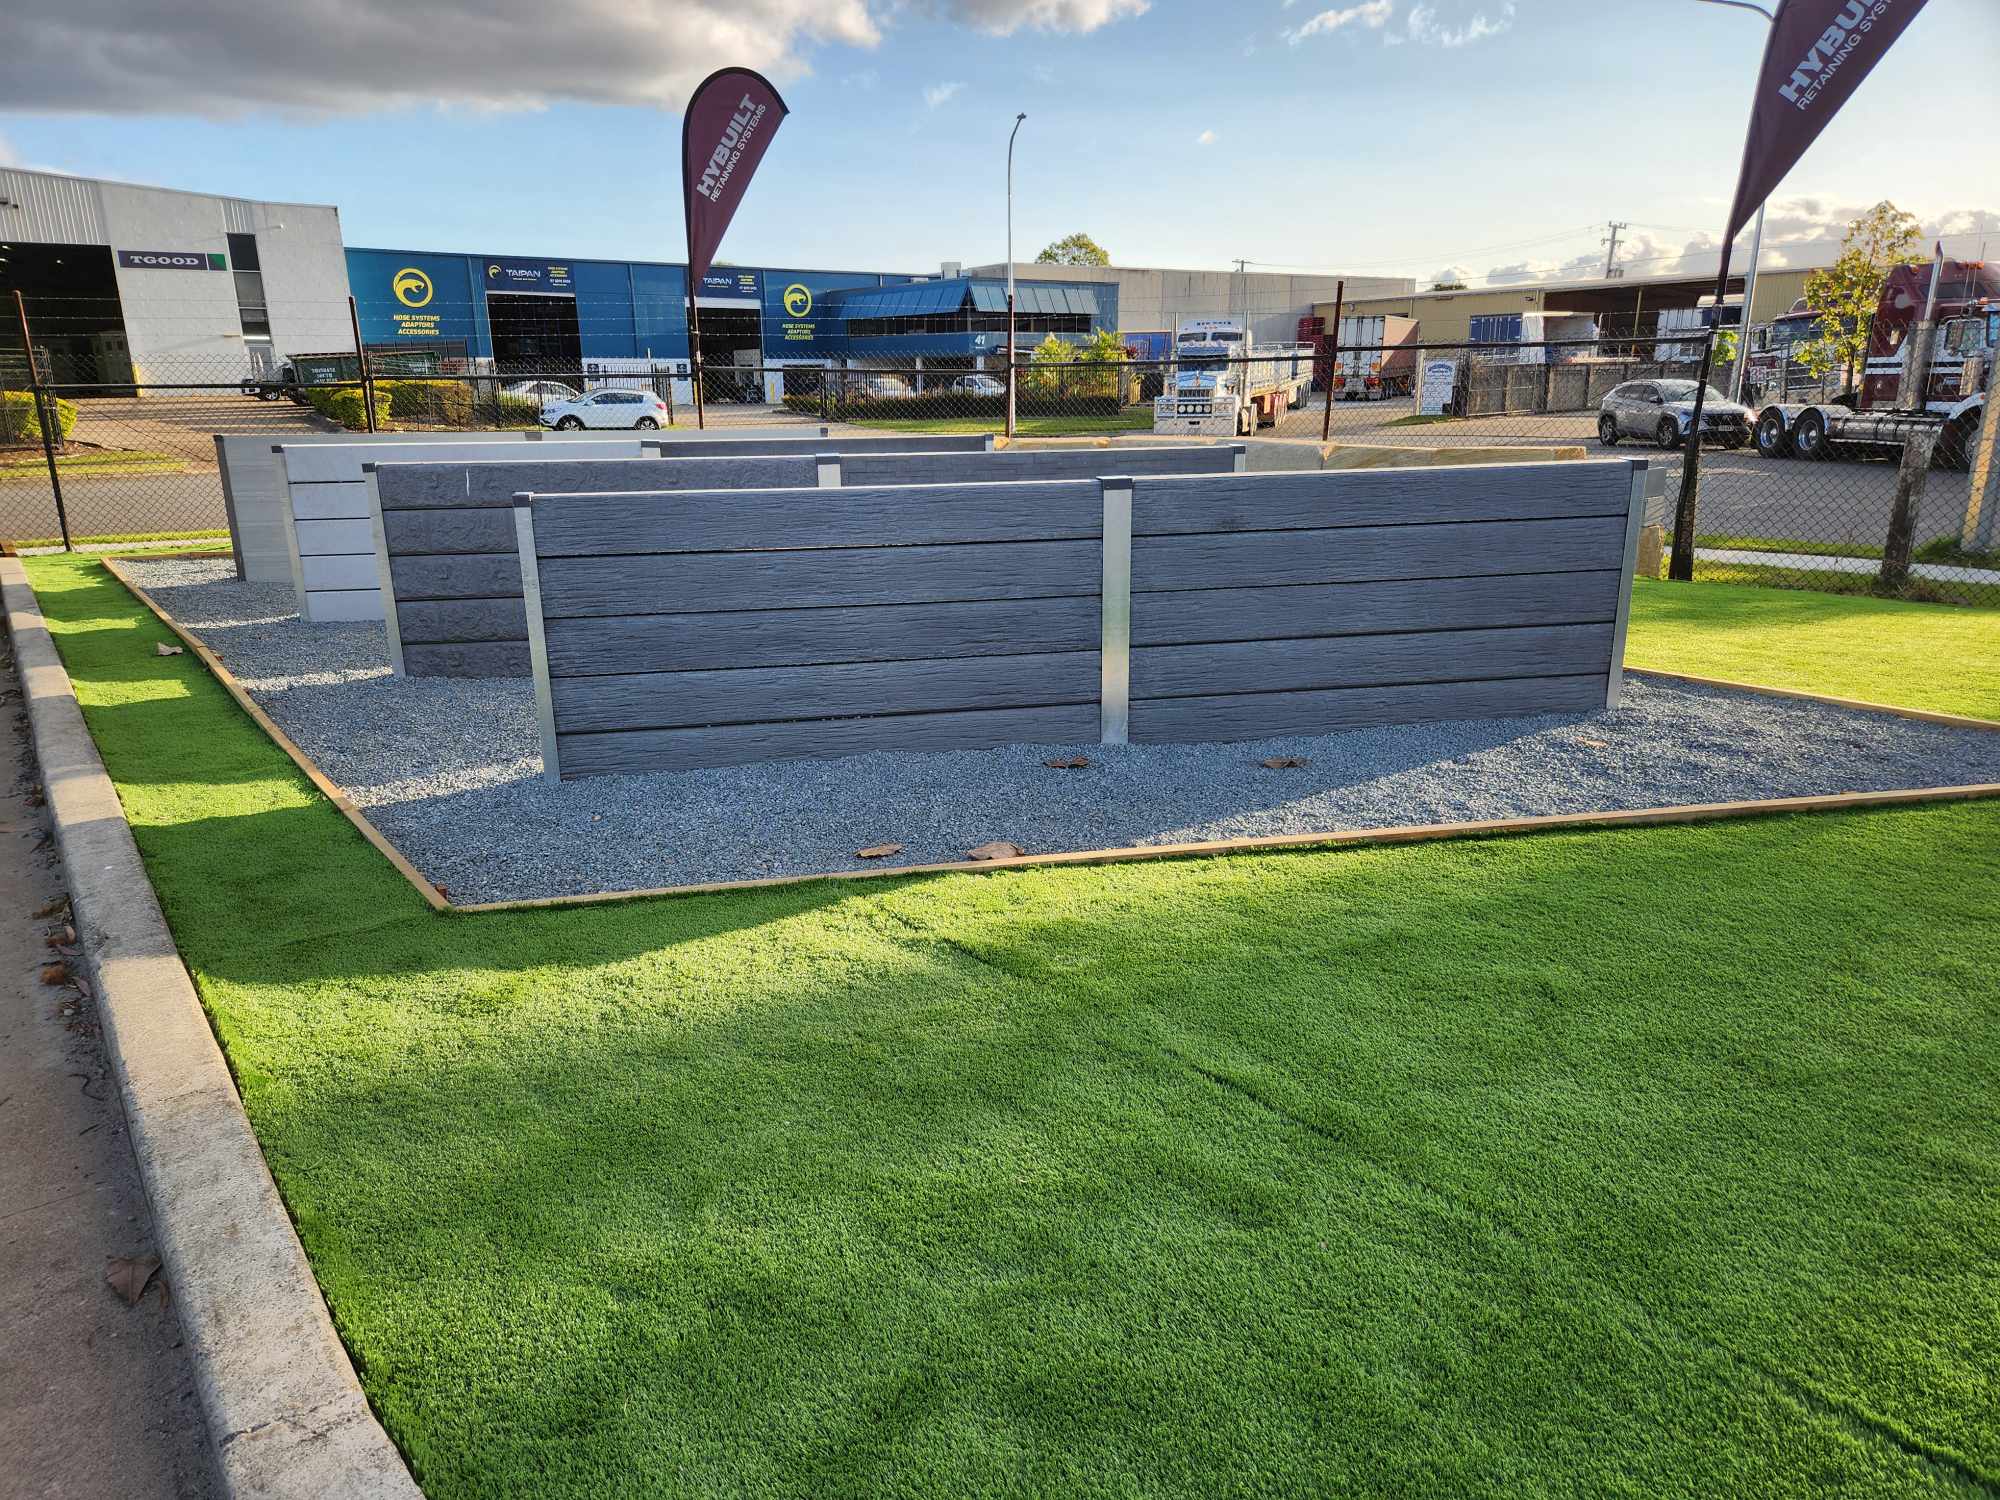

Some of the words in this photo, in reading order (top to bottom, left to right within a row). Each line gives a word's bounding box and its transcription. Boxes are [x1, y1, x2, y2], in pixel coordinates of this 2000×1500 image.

[1796, 33, 1861, 110] RETAINING
[696, 93, 756, 197] HYBUILT
[710, 150, 741, 202] RETAINING
[737, 104, 767, 151] SYSTEMS
[130, 255, 199, 265] TGOOD
[506, 269, 541, 278] TAIPAN
[703, 277, 732, 285] TAIPAN
[974, 334, 986, 345] 41
